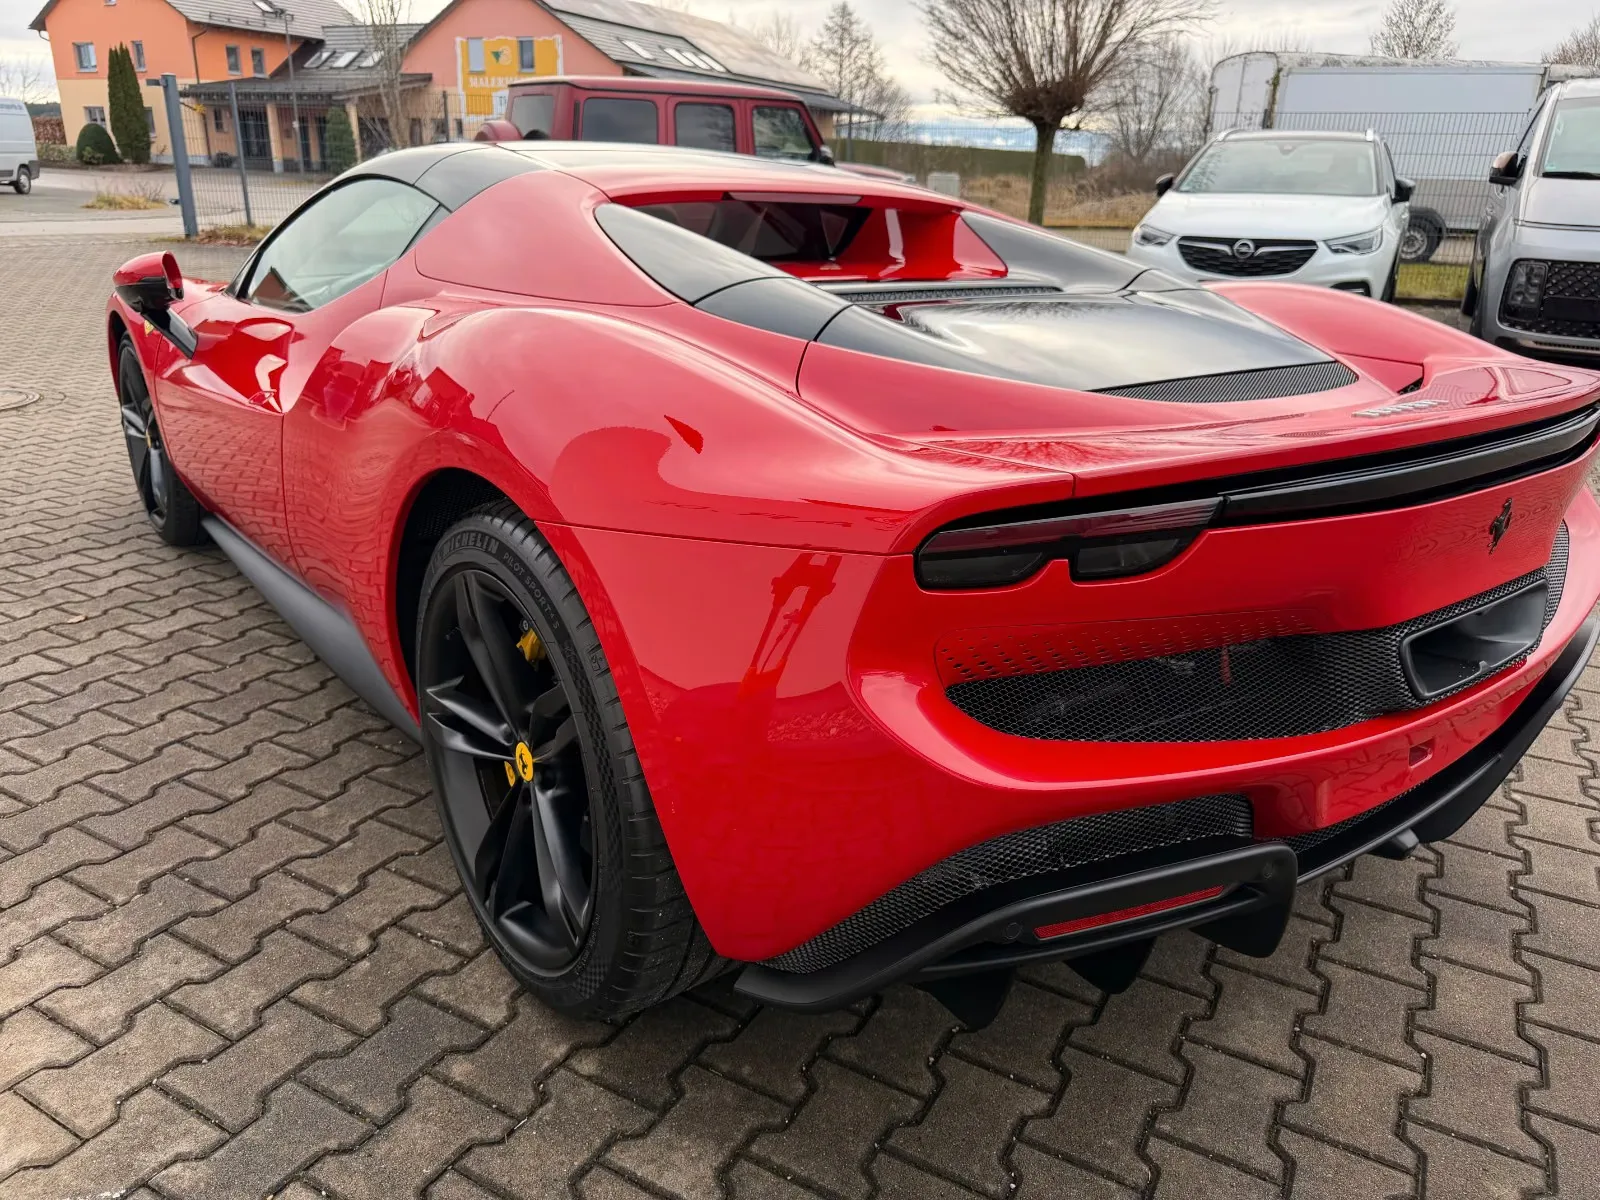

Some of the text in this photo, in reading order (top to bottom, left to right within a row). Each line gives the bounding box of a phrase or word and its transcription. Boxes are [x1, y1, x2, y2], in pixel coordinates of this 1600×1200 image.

[443, 531, 500, 554] MICHELIN
[503, 551, 526, 576] PILOT
[525, 575, 552, 613] SPORT
